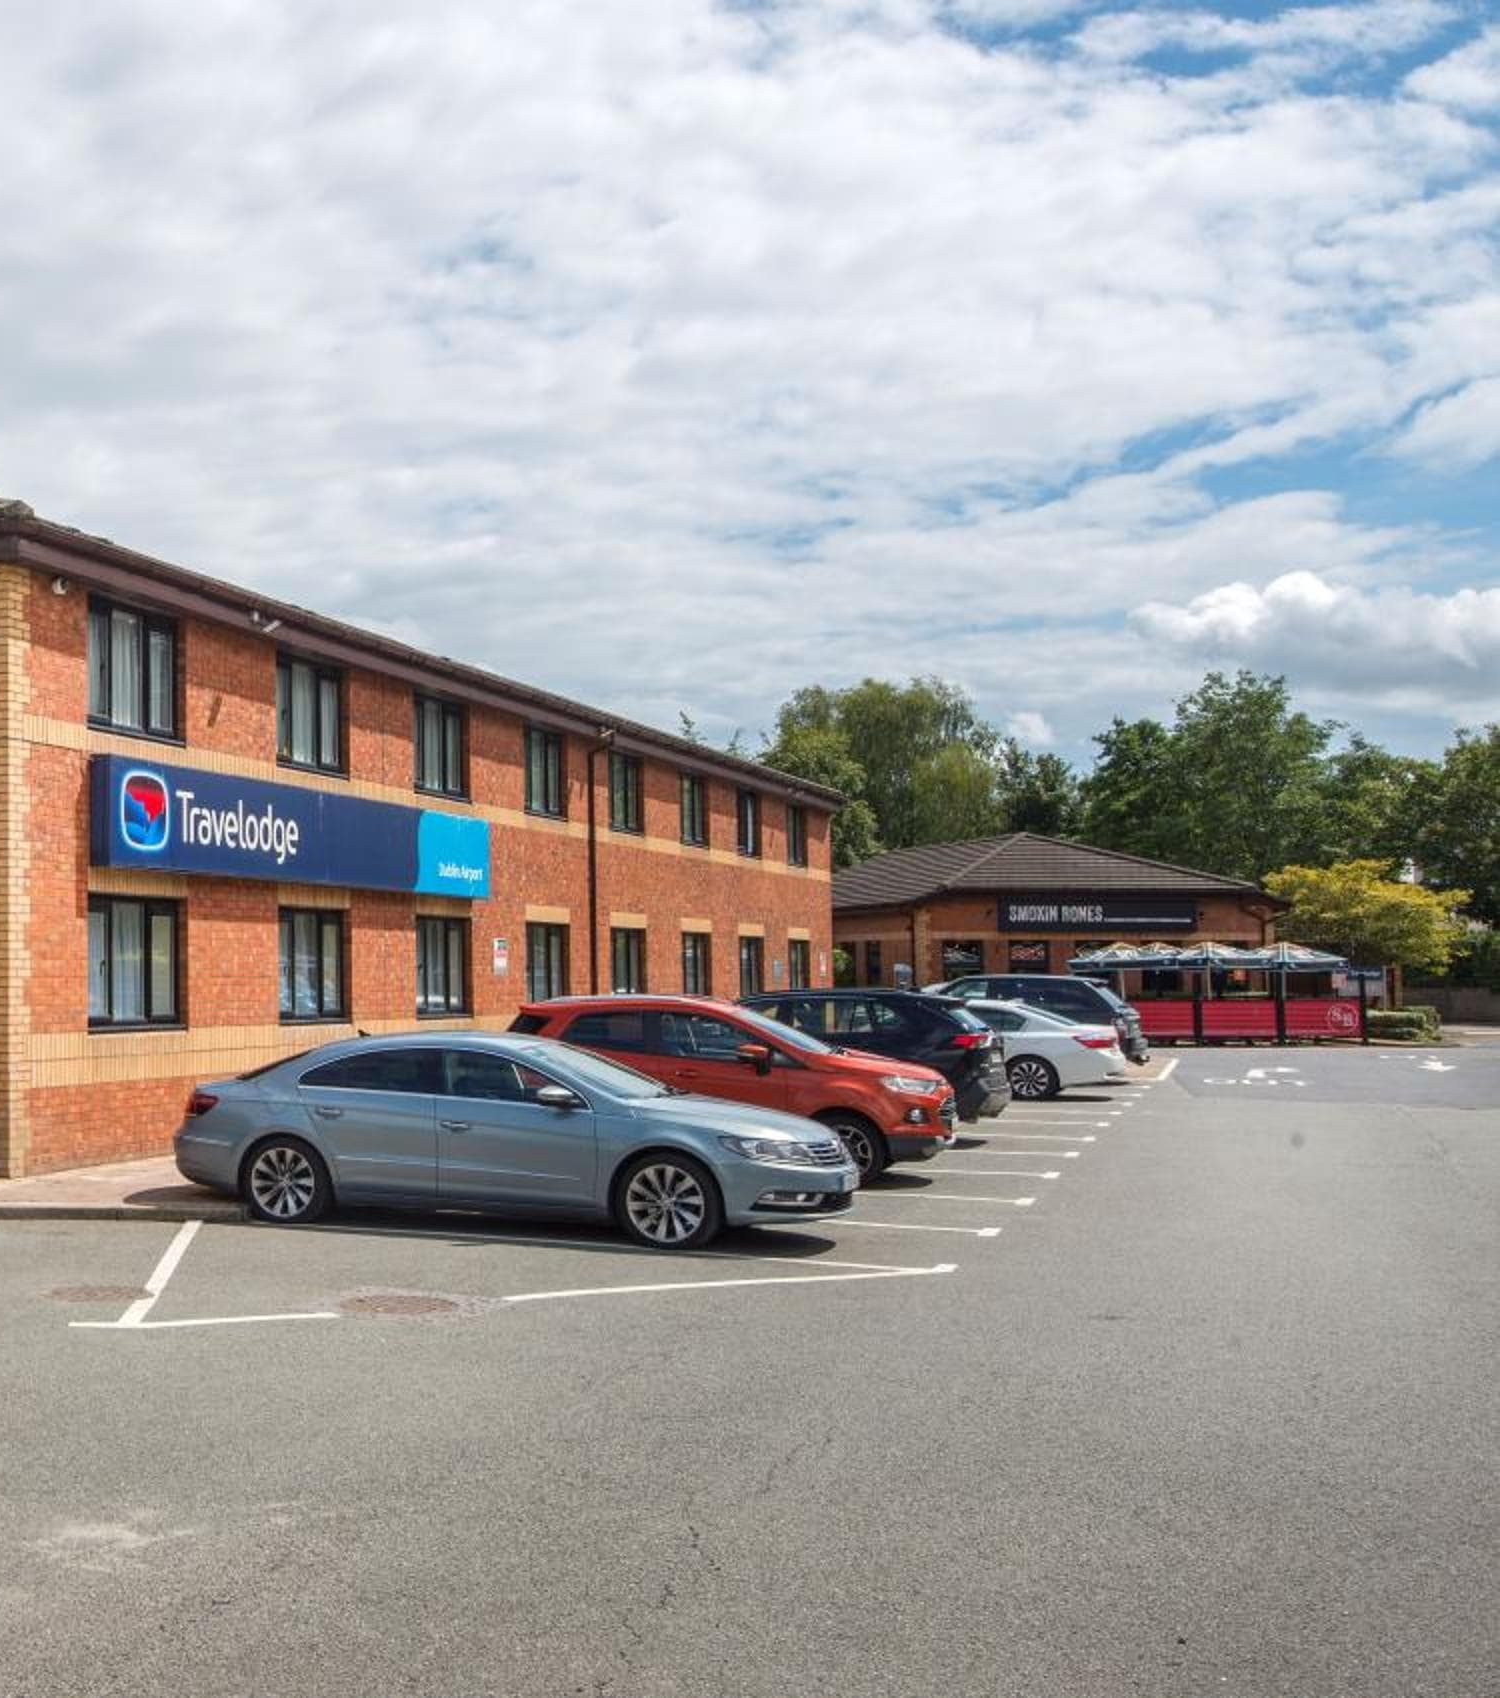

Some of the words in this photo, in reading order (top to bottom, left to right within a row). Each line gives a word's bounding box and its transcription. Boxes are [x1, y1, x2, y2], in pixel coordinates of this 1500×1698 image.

[175, 790, 300, 864] Travelodge
[460, 865, 483, 884] Airport
[1061, 905, 1103, 923] BONES
